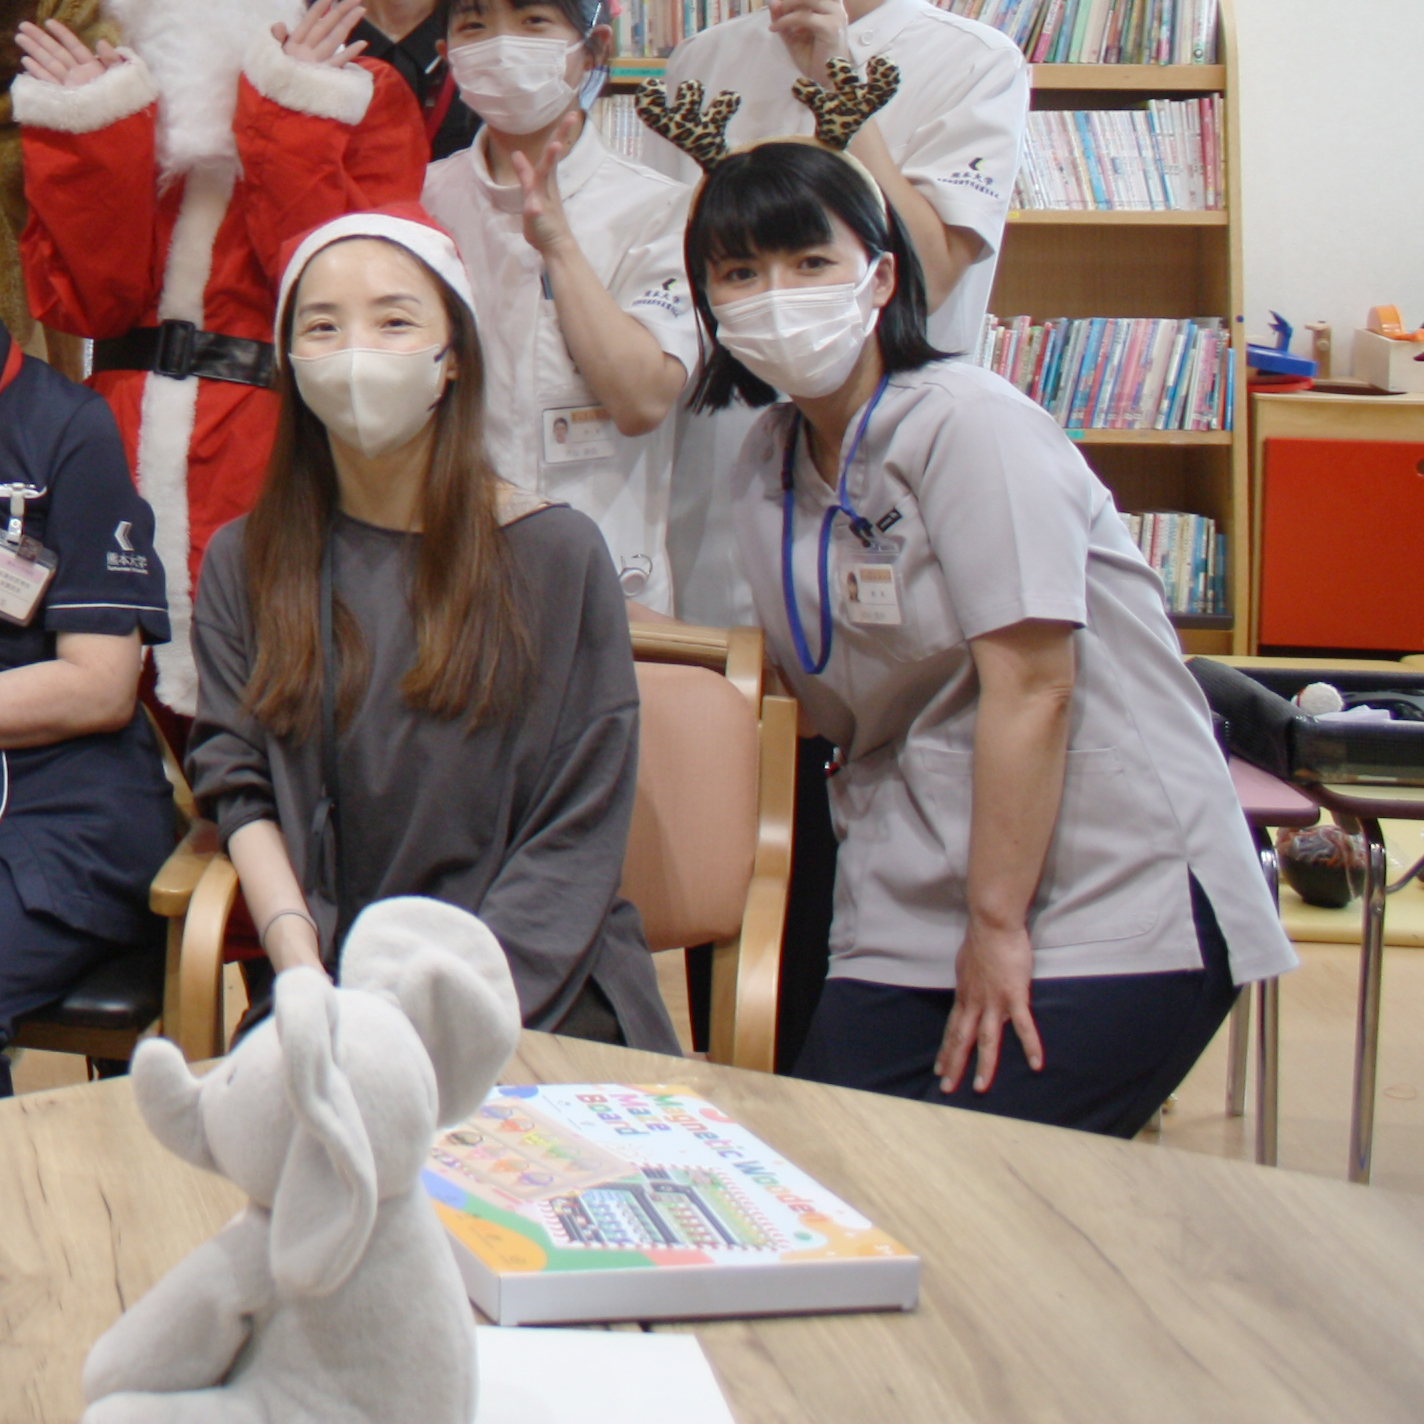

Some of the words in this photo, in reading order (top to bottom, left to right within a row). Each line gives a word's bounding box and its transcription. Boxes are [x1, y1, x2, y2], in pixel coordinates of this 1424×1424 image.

[574, 1093, 650, 1136] Board
[608, 1093, 672, 1132] Maze
[645, 1093, 745, 1159] Magnetic
